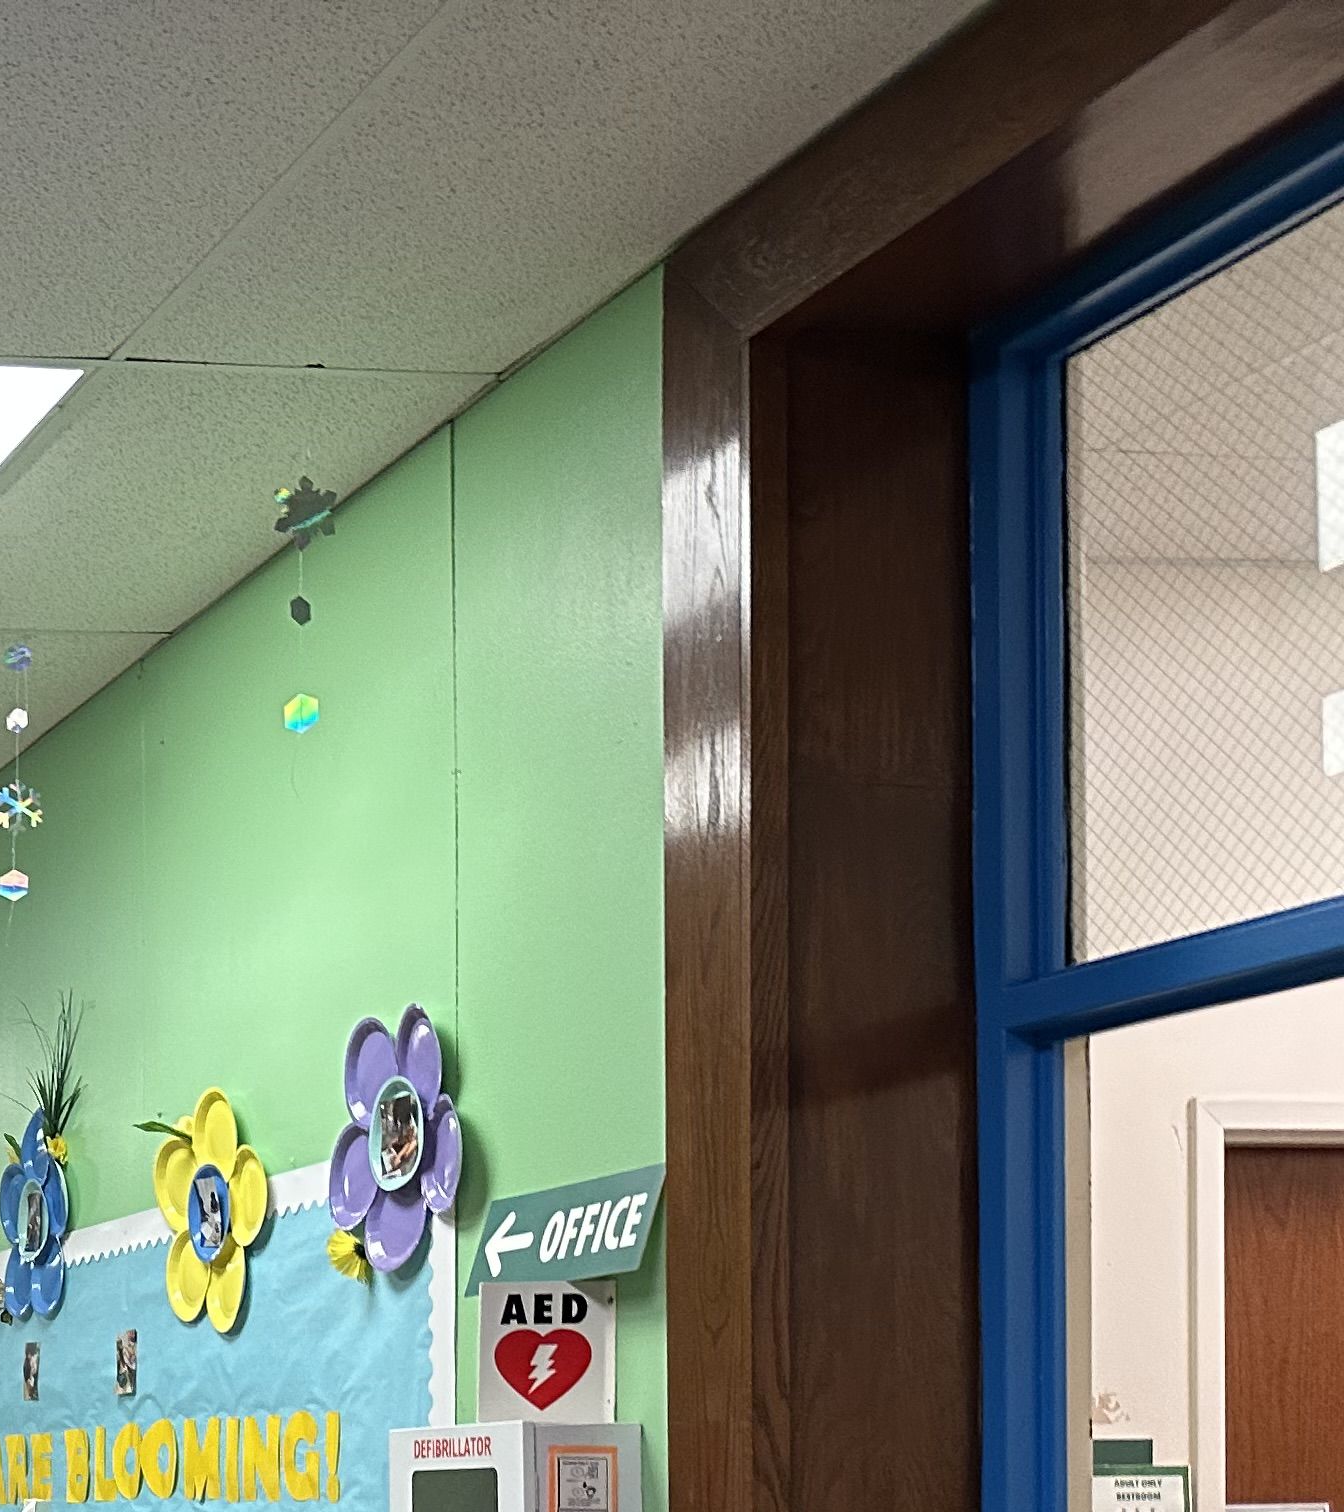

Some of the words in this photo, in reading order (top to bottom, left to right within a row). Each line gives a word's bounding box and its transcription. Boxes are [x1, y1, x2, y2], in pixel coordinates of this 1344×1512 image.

[539, 1192, 648, 1263] OFFICE
[500, 1293, 588, 1326] AED
[64, 1410, 341, 1504] BLOOMING!
[414, 1436, 492, 1459] DEFIBRILLATOR
